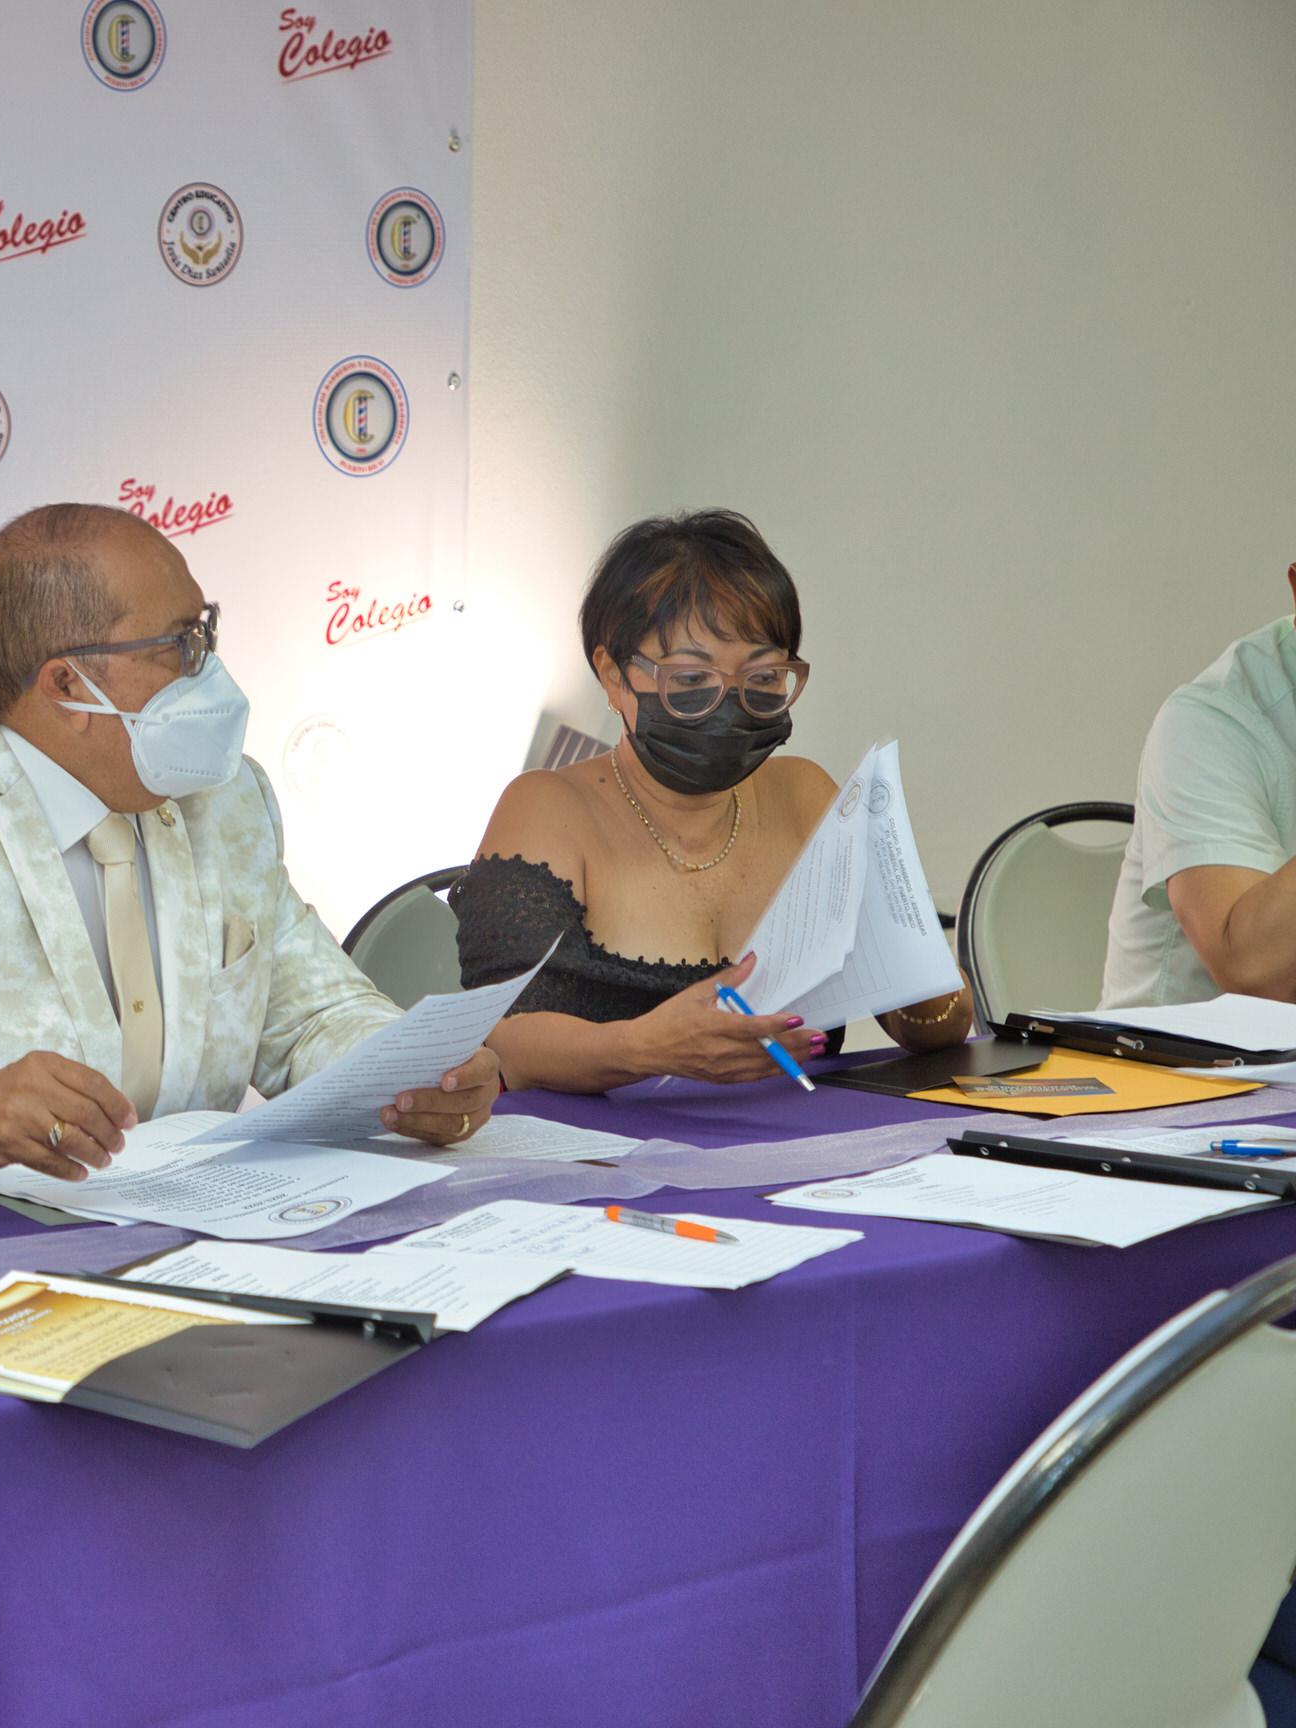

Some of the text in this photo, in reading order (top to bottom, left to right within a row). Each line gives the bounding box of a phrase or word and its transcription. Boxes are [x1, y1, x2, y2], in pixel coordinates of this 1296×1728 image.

[278, 7, 316, 34] Soy
[278, 27, 393, 78] Colegio
[117, 478, 156, 502] Soy
[326, 580, 361, 601] Soy
[325, 593, 433, 646] Colegio
